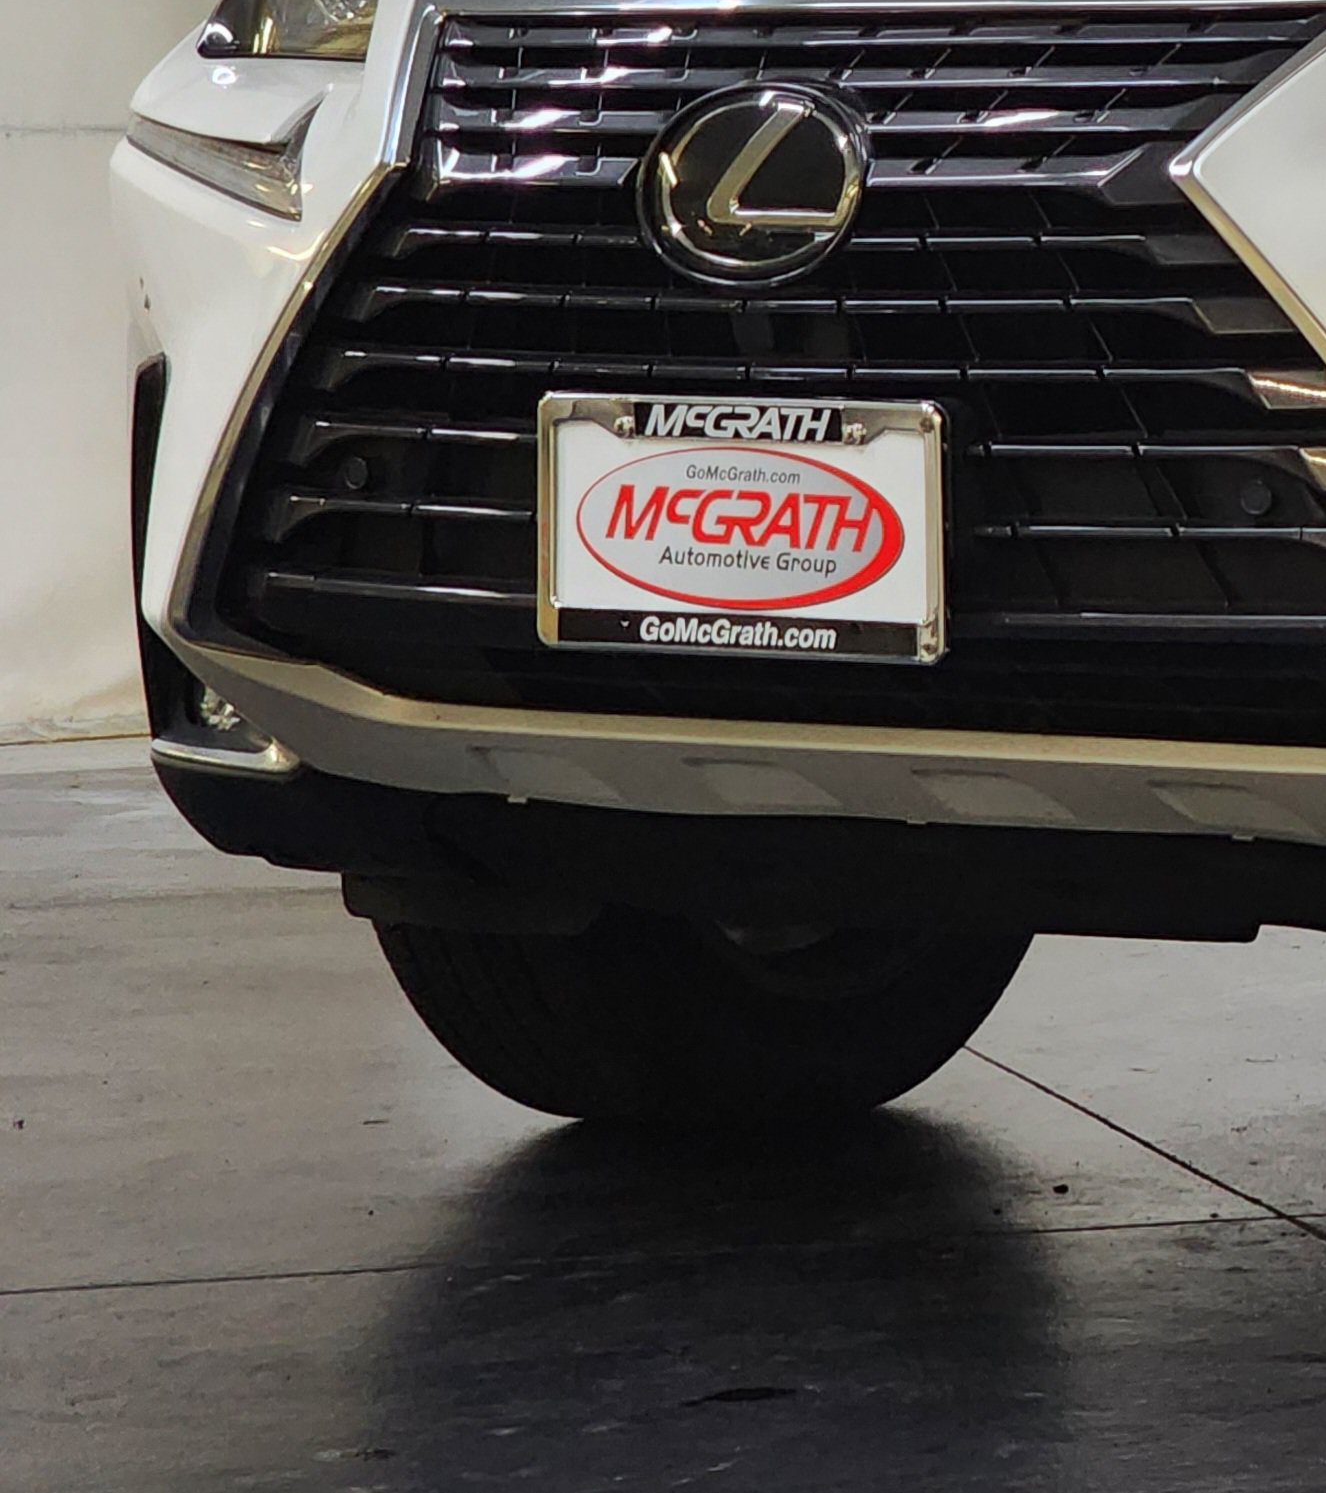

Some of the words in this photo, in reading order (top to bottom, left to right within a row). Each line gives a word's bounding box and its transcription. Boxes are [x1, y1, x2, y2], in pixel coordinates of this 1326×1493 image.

[686, 464, 801, 485] GoMcGrath.com
[658, 546, 771, 570] Automotive
[776, 552, 838, 578] Group
[639, 615, 837, 650] GoMcGrath.com
